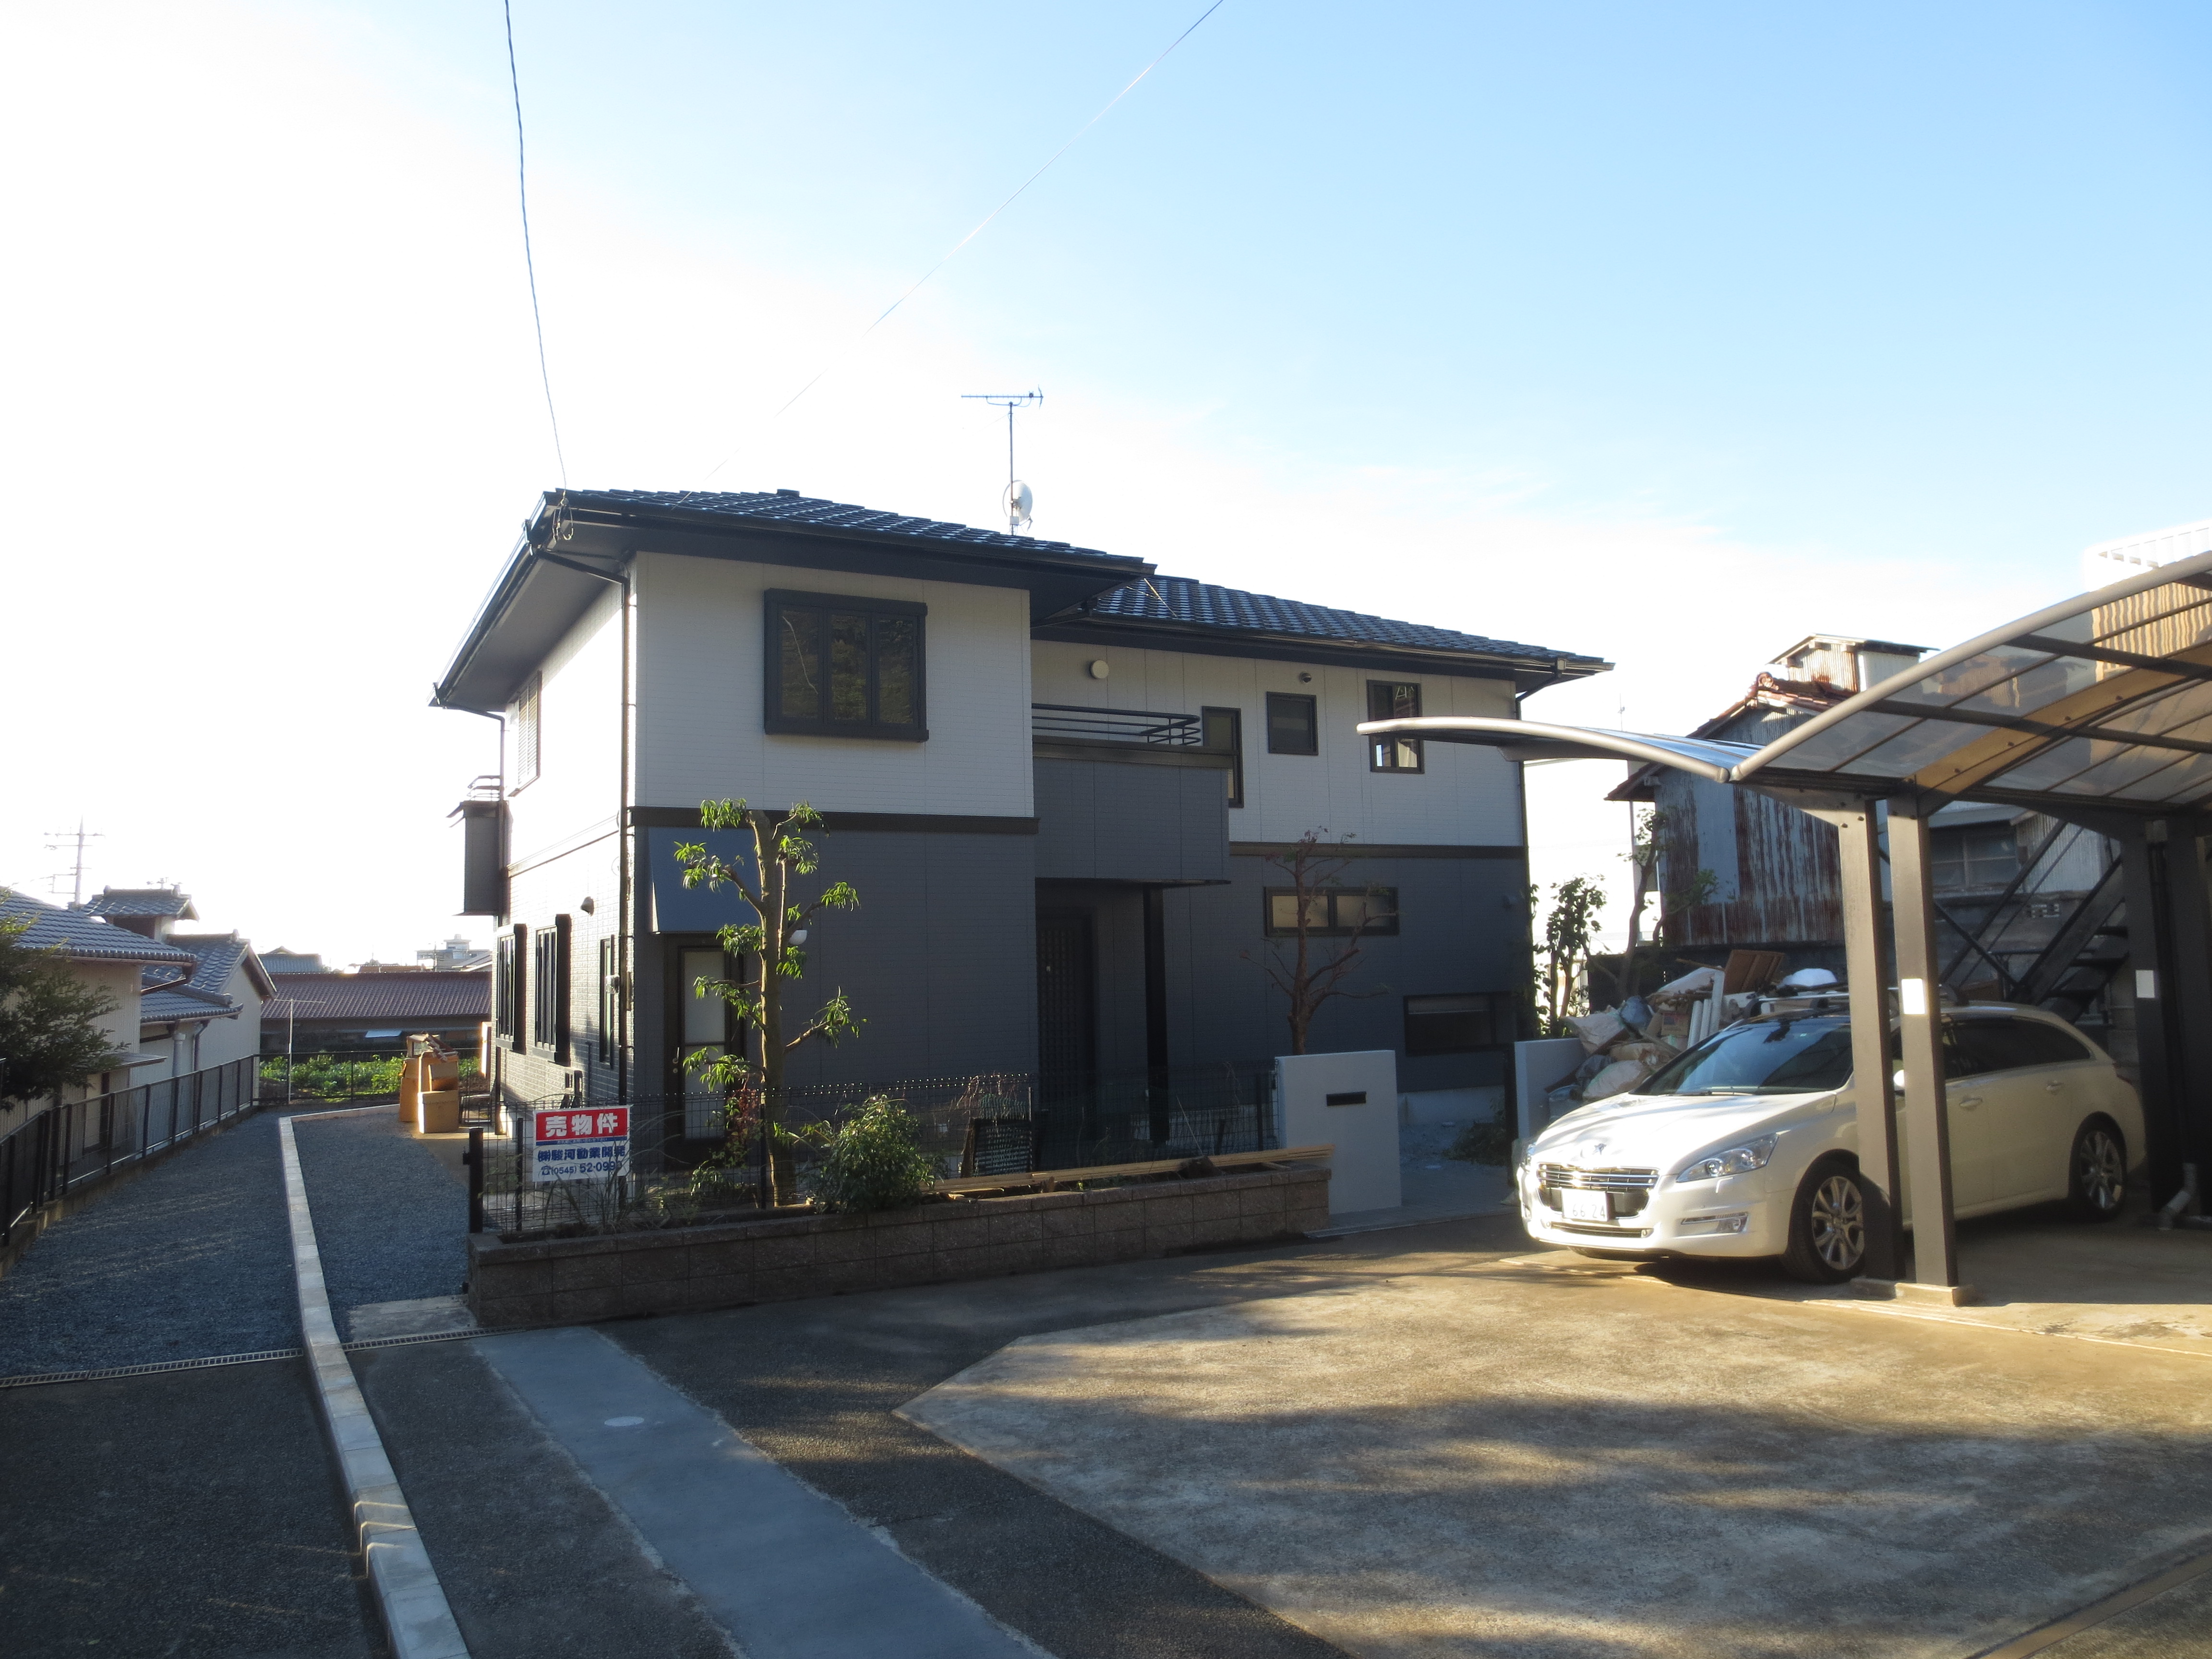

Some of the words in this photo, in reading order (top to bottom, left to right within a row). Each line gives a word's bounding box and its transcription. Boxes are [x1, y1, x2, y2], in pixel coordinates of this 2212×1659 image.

[545, 1112, 618, 1138] 売物件
[552, 1166, 577, 1175] (0545)
